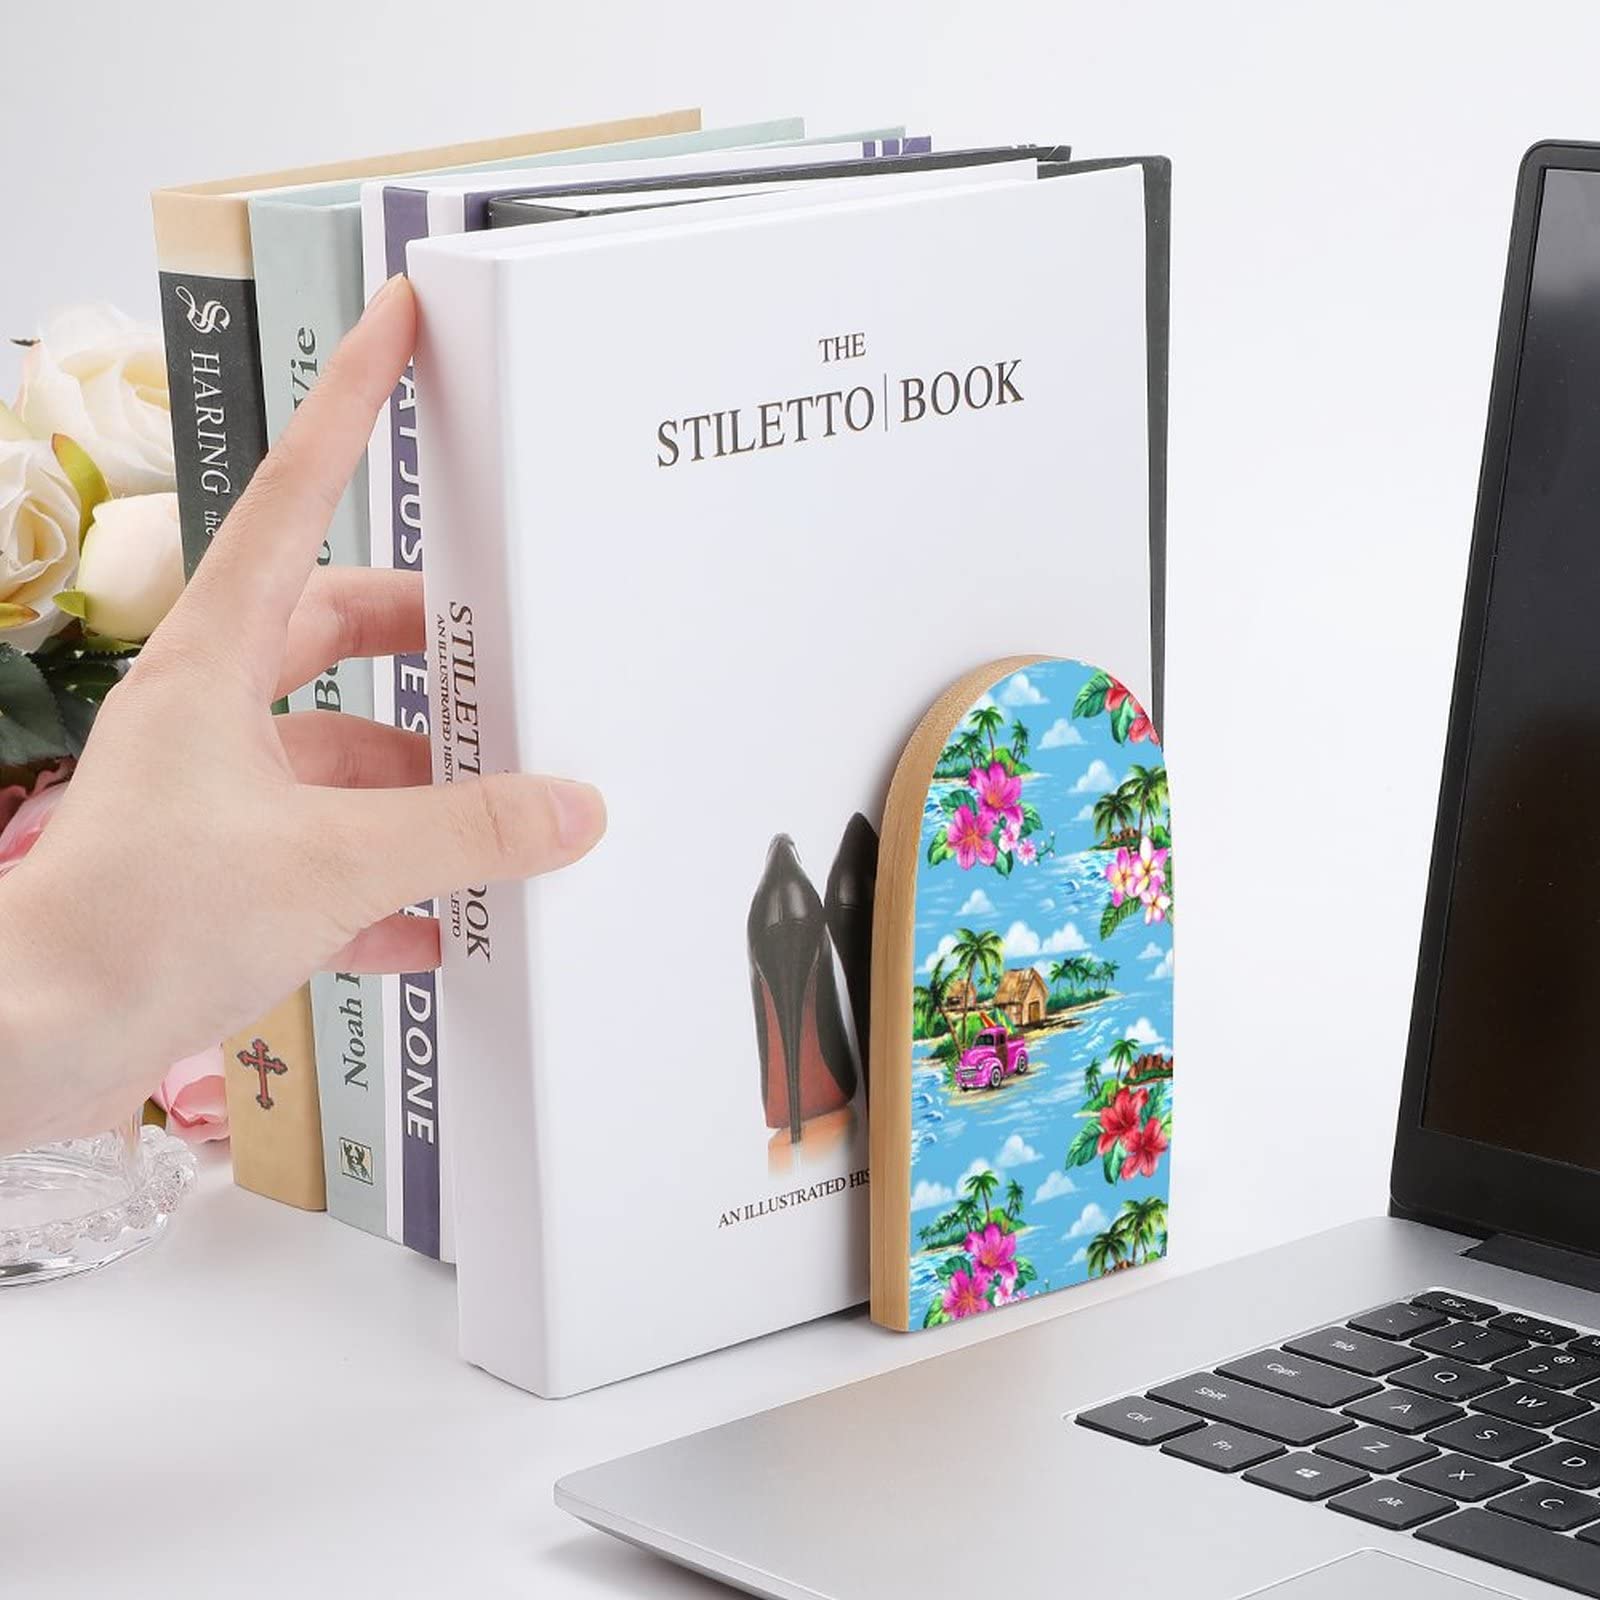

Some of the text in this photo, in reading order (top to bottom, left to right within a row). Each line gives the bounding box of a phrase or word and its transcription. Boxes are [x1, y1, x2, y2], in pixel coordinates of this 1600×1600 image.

[818, 332, 866, 363] THE
[656, 359, 1025, 468] STILETTO BOOK
[436, 613, 446, 639] AN
[438, 640, 451, 742] ILLUSTRATED
[449, 601, 481, 777] STILETT
[338, 997, 369, 1093] Noah
[404, 983, 435, 1146] DONE
[718, 1207, 742, 1228] AN
[744, 1177, 847, 1221] ILLUSTRATED
[1451, 1340, 1465, 1349] 1
[1527, 1364, 1549, 1374] 2
[1434, 1371, 1459, 1384] Q
[1194, 1386, 1228, 1400] Shift
[1515, 1395, 1548, 1408] W
[1388, 1403, 1412, 1414] A
[1126, 1411, 1153, 1424] Ctrl
[1475, 1429, 1499, 1441] S
[1212, 1439, 1233, 1451] Fn
[1363, 1441, 1391, 1454] Z
[1561, 1455, 1587, 1468] D
[1448, 1469, 1476, 1481] X
[1377, 1496, 1404, 1507] Alt
[1539, 1498, 1565, 1510] C
